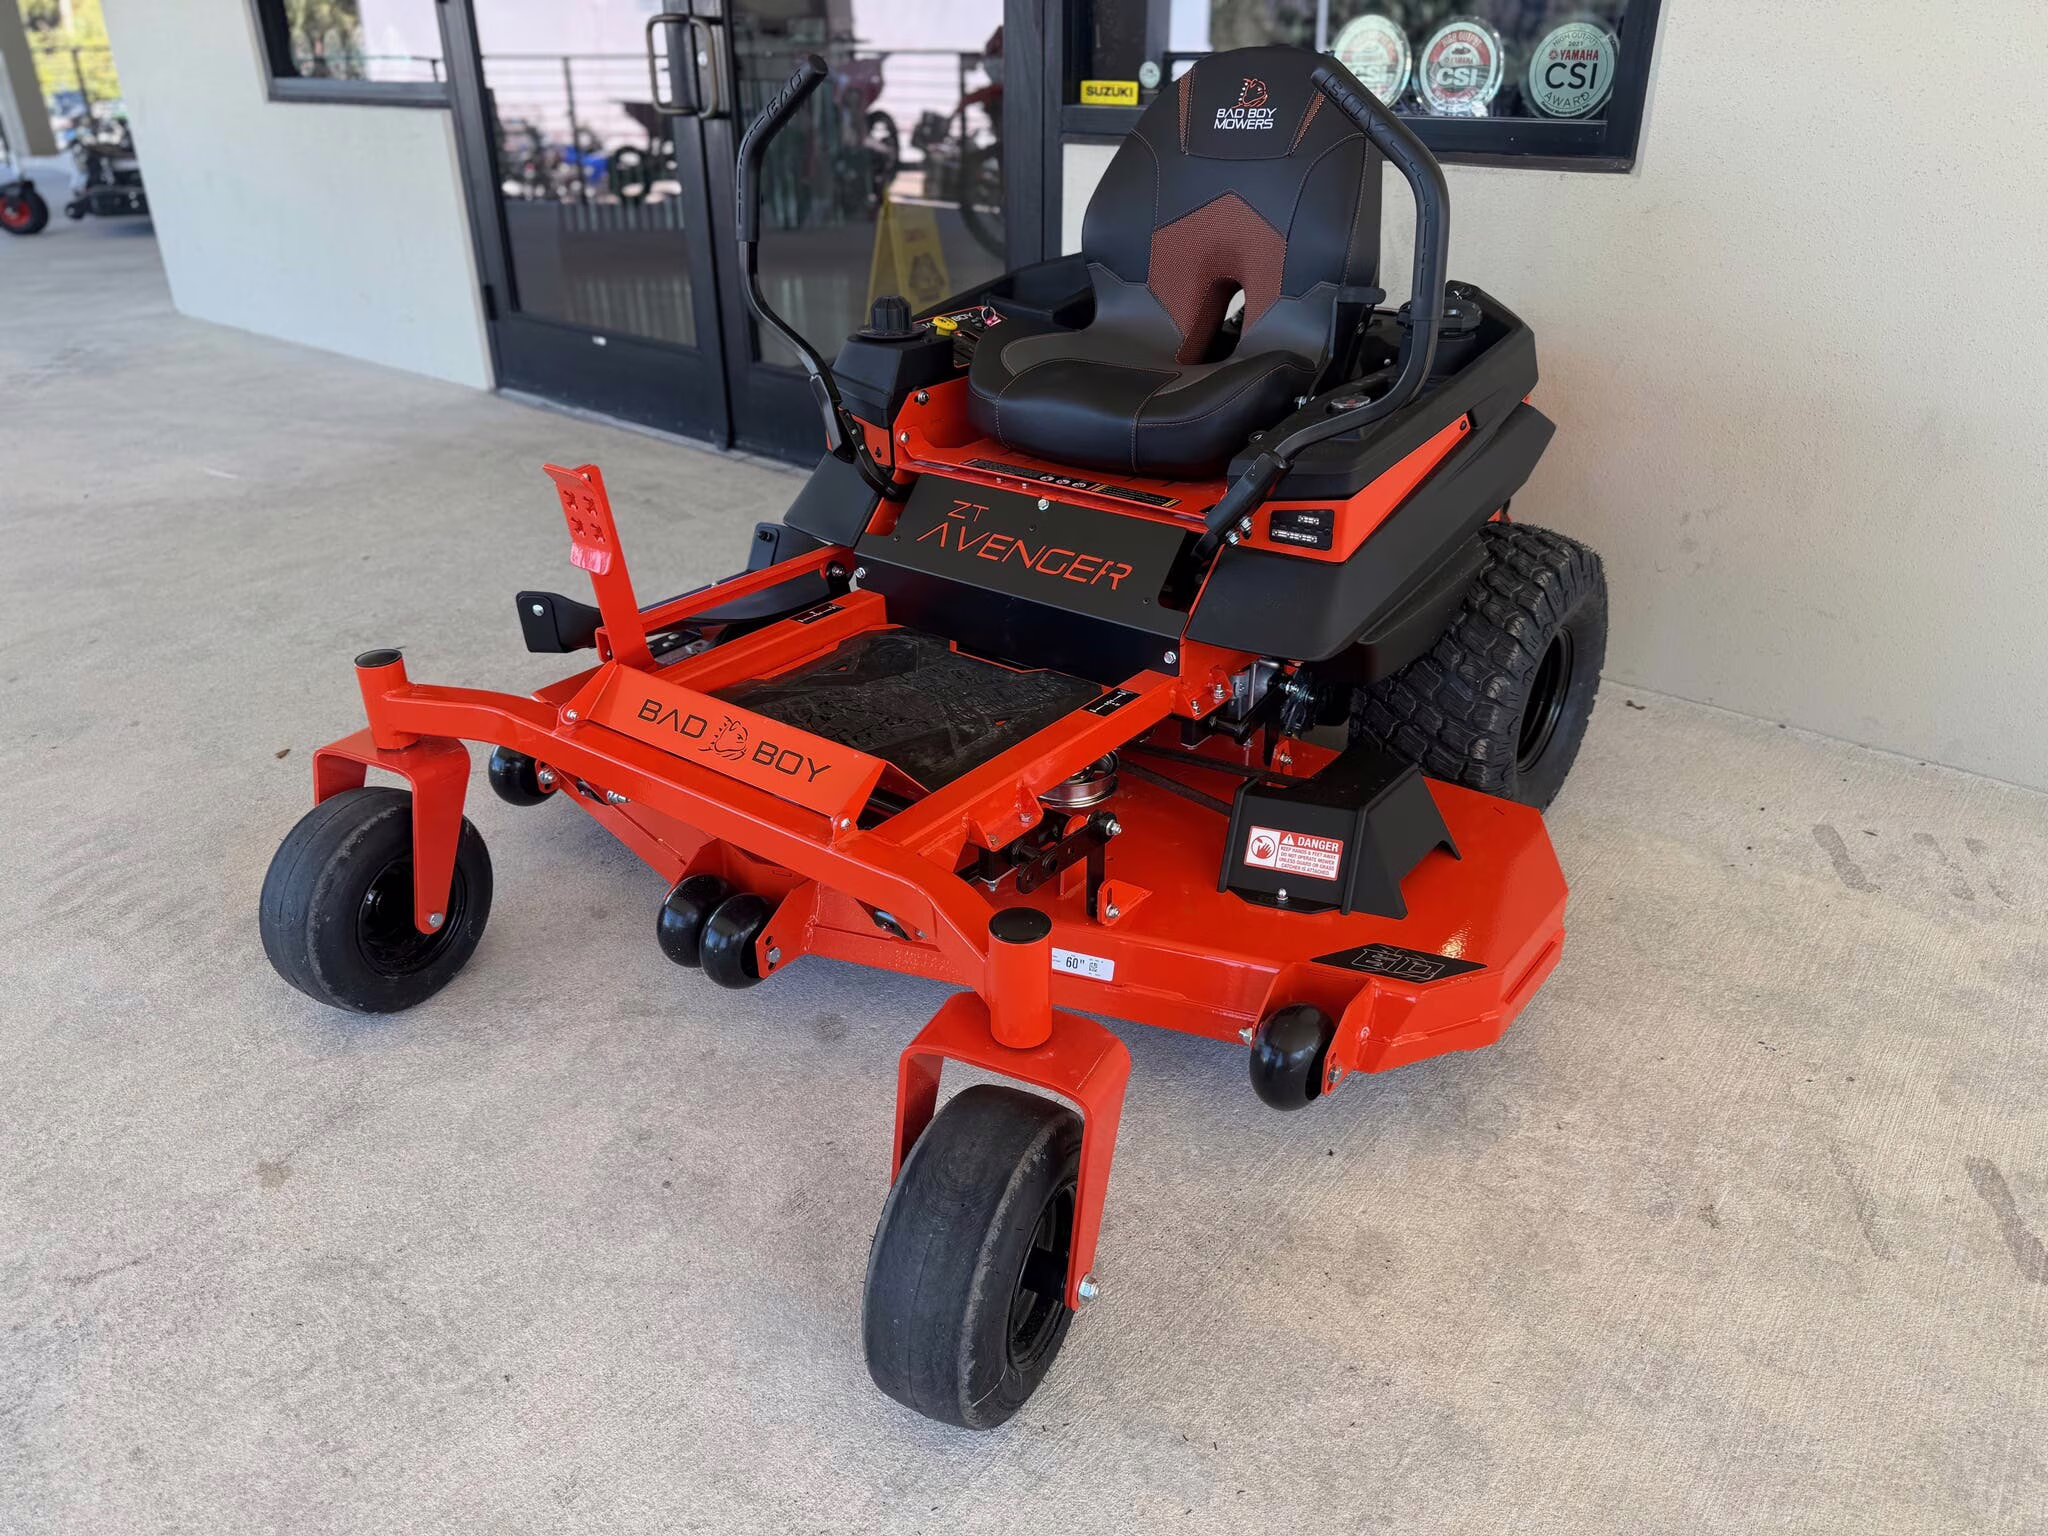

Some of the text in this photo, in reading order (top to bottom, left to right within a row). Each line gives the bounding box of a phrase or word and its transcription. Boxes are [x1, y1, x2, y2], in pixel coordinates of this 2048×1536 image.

[1560, 49, 1599, 61] YAMAHA
[1438, 67, 1478, 86] CSI
[1545, 62, 1597, 89] CSI
[1086, 86, 1133, 98] SUZUKI
[1544, 91, 1590, 108] AWARD
[1216, 107, 1277, 118] BAD BOY
[1213, 119, 1274, 129] MOWERS
[948, 500, 990, 522] ZT
[916, 521, 1134, 591] AVENGER
[637, 699, 832, 783] BAD BOY
[1298, 837, 1338, 852] DANGER
